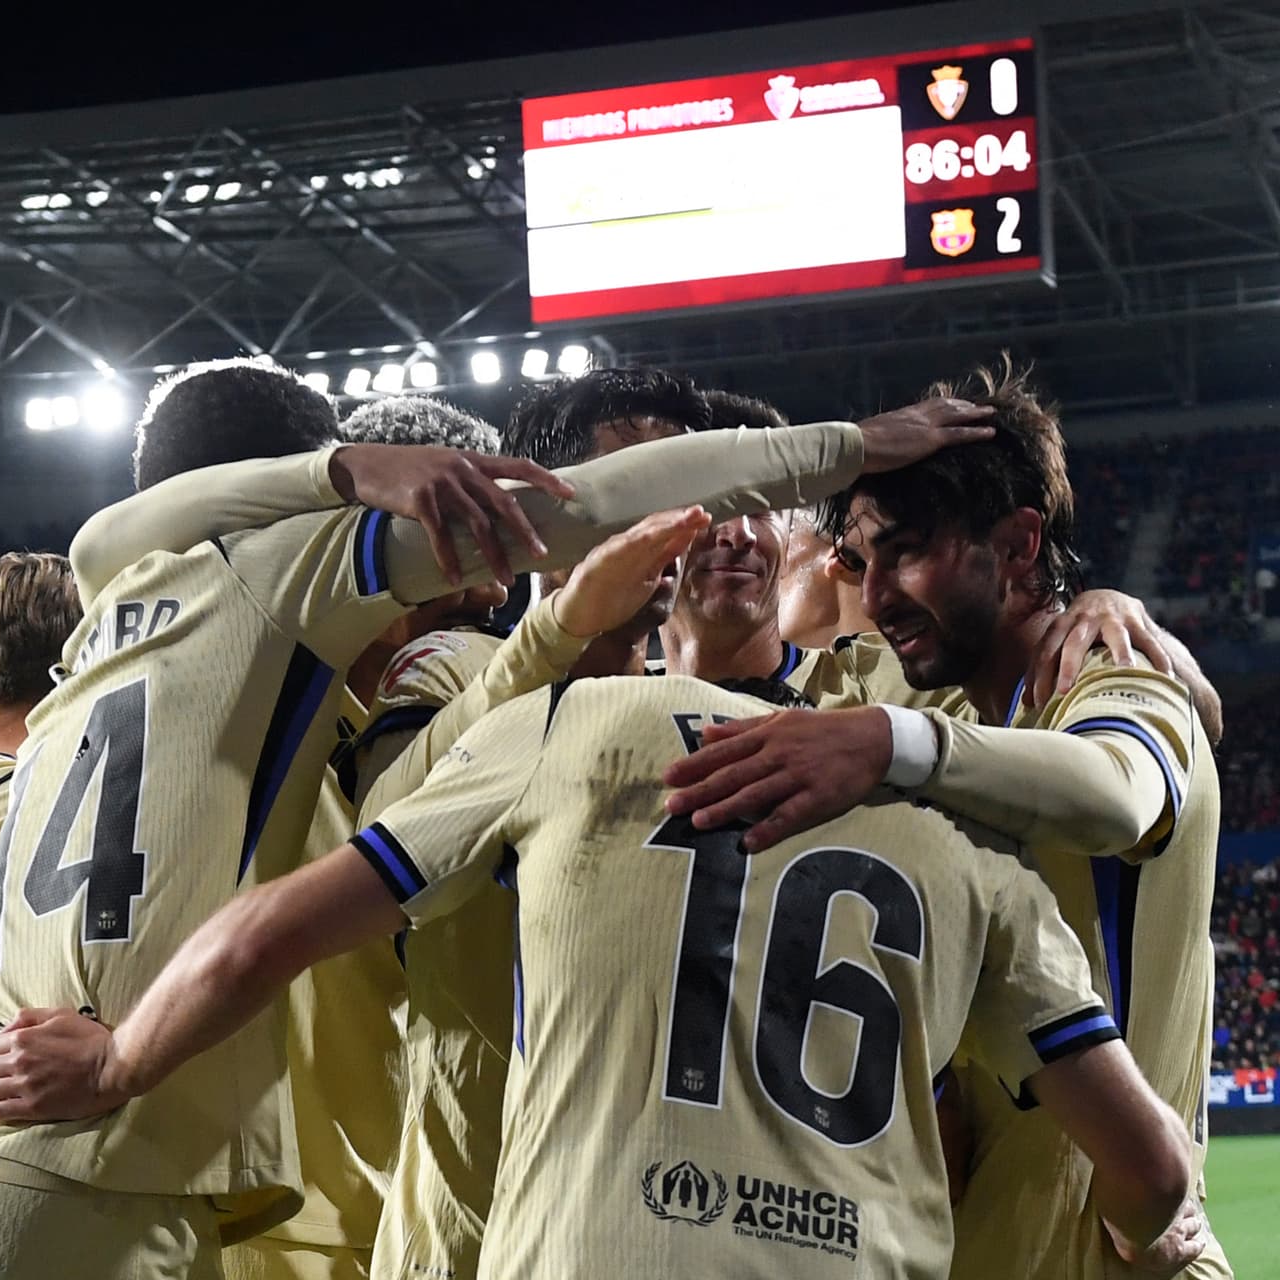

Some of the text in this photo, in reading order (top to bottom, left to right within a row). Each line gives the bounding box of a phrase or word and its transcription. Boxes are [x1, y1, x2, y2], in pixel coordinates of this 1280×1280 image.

[905, 130, 1031, 184] 86:04
[996, 197, 1022, 253] 2
[644, 806, 926, 1149] 16
[736, 1175, 859, 1223] UNHCR
[732, 1202, 859, 1249] ACNUR
[734, 1226, 858, 1262] The UN Refugee Agency
